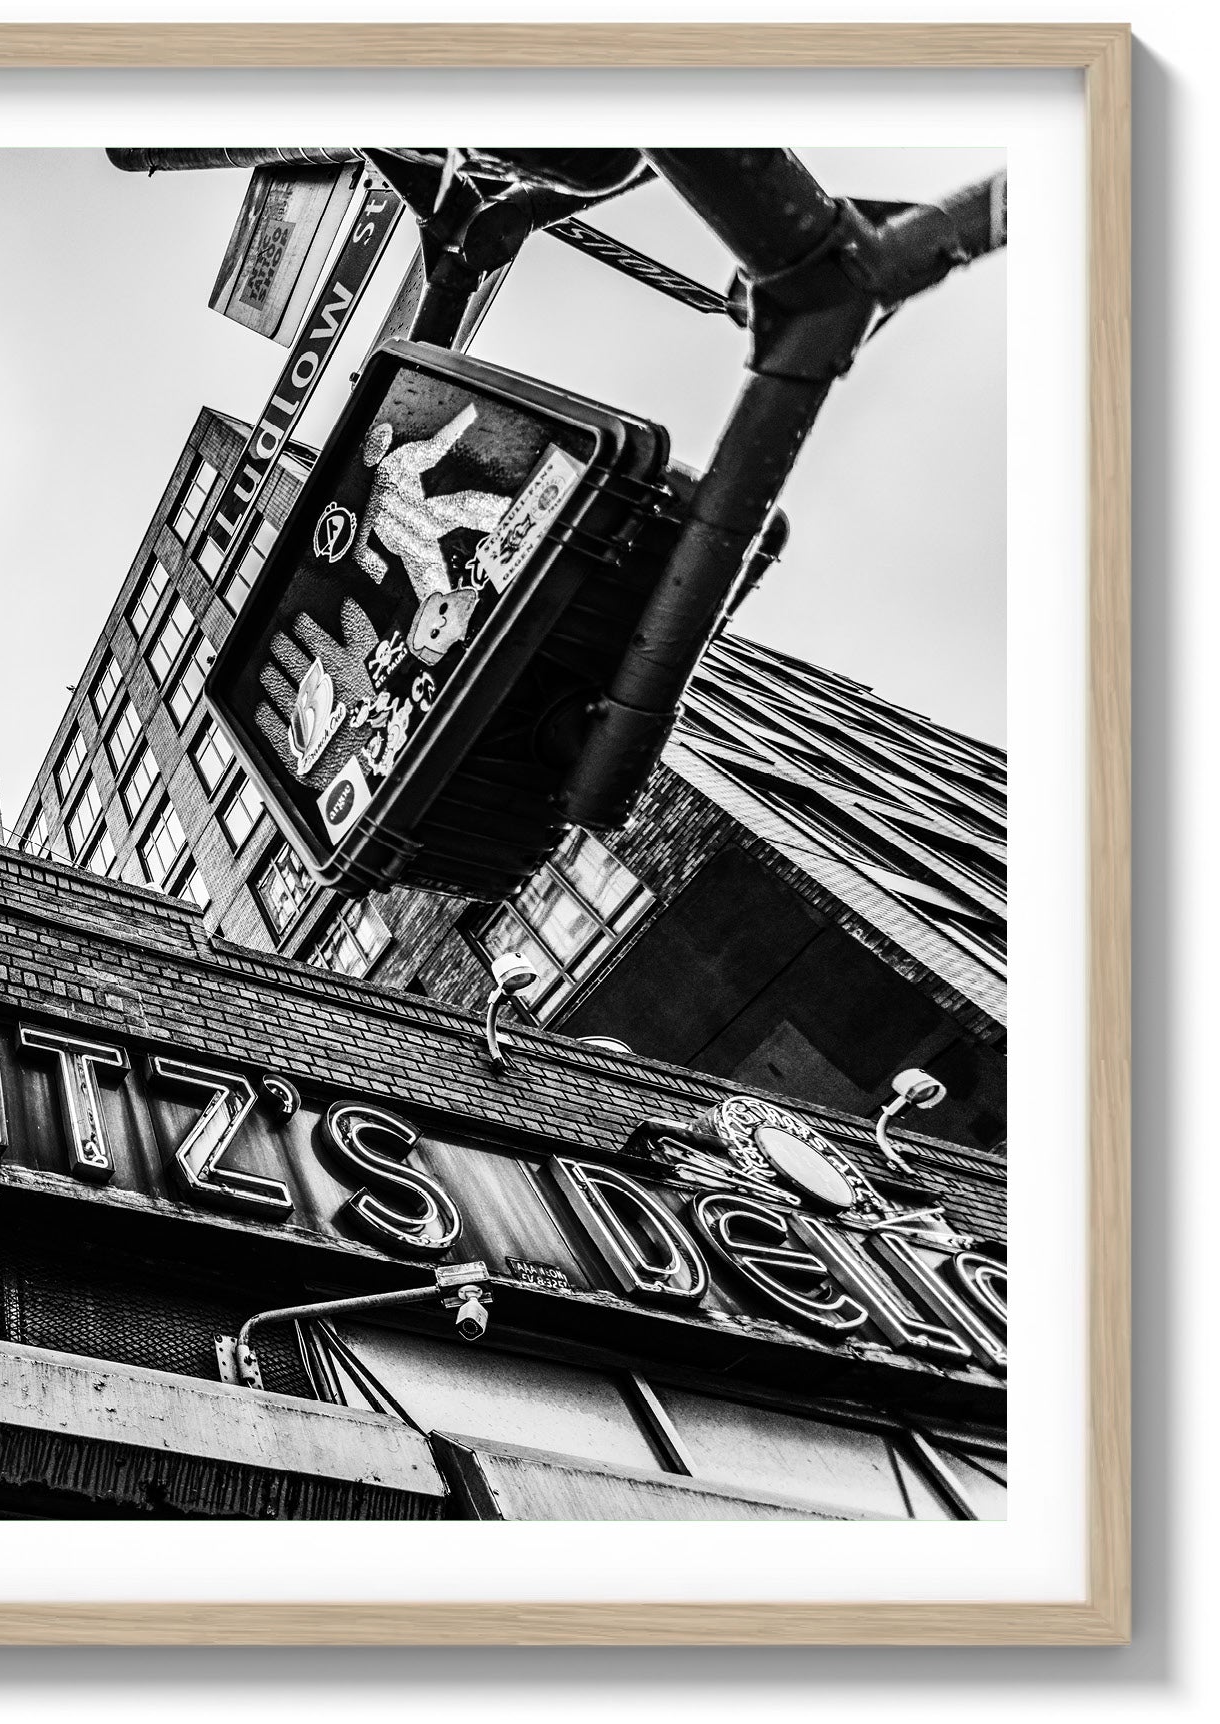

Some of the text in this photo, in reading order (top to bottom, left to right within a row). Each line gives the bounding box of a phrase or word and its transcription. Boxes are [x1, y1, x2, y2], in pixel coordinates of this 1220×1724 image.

[249, 227, 282, 300] TATTOO
[258, 228, 288, 303] SHOP
[216, 198, 388, 537] Ludlow St
